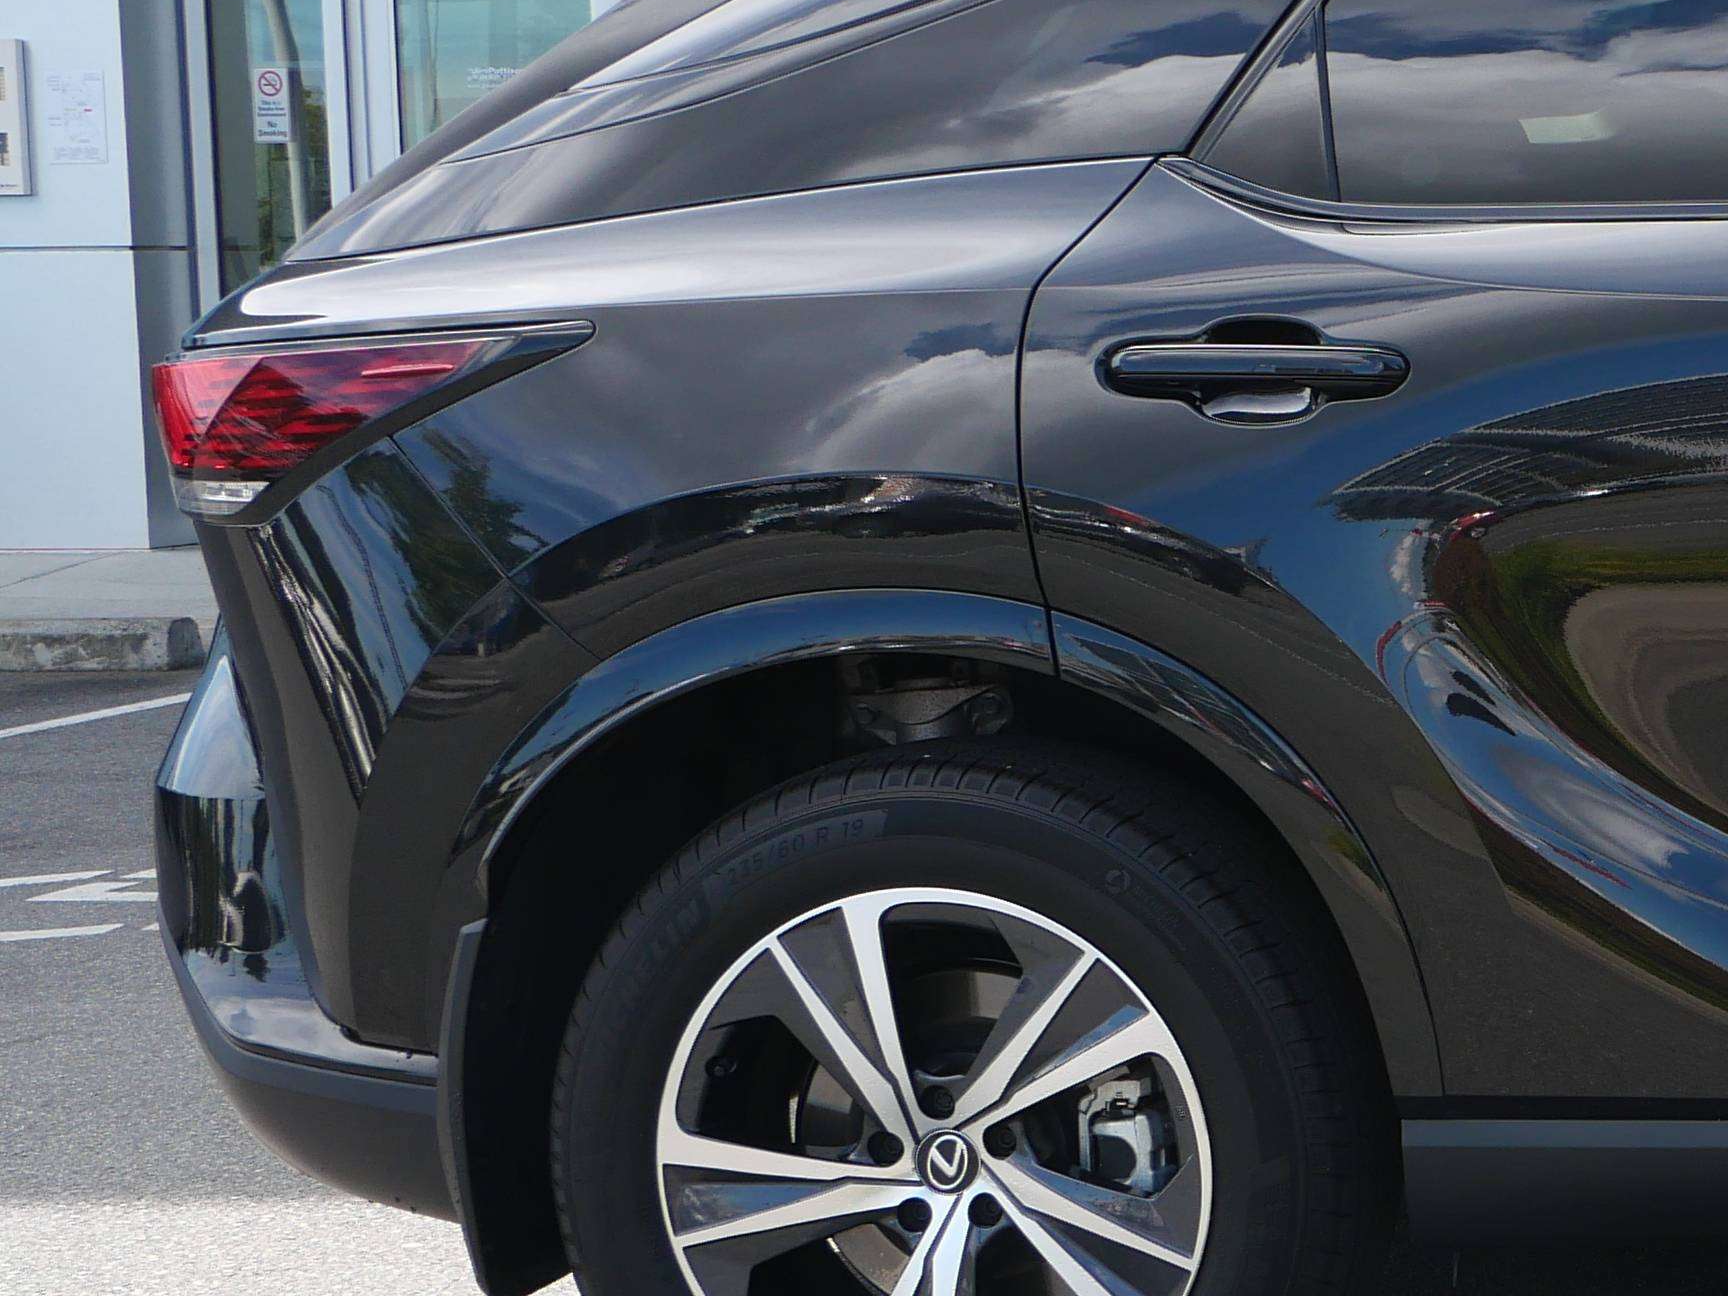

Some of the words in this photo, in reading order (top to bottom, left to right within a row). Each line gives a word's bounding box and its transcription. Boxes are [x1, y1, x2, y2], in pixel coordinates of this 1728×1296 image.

[267, 120, 278, 128] No
[257, 129, 288, 138] Smoking
[728, 835, 805, 886] 235/60
[816, 826, 829, 845] R
[842, 818, 865, 839] 19
